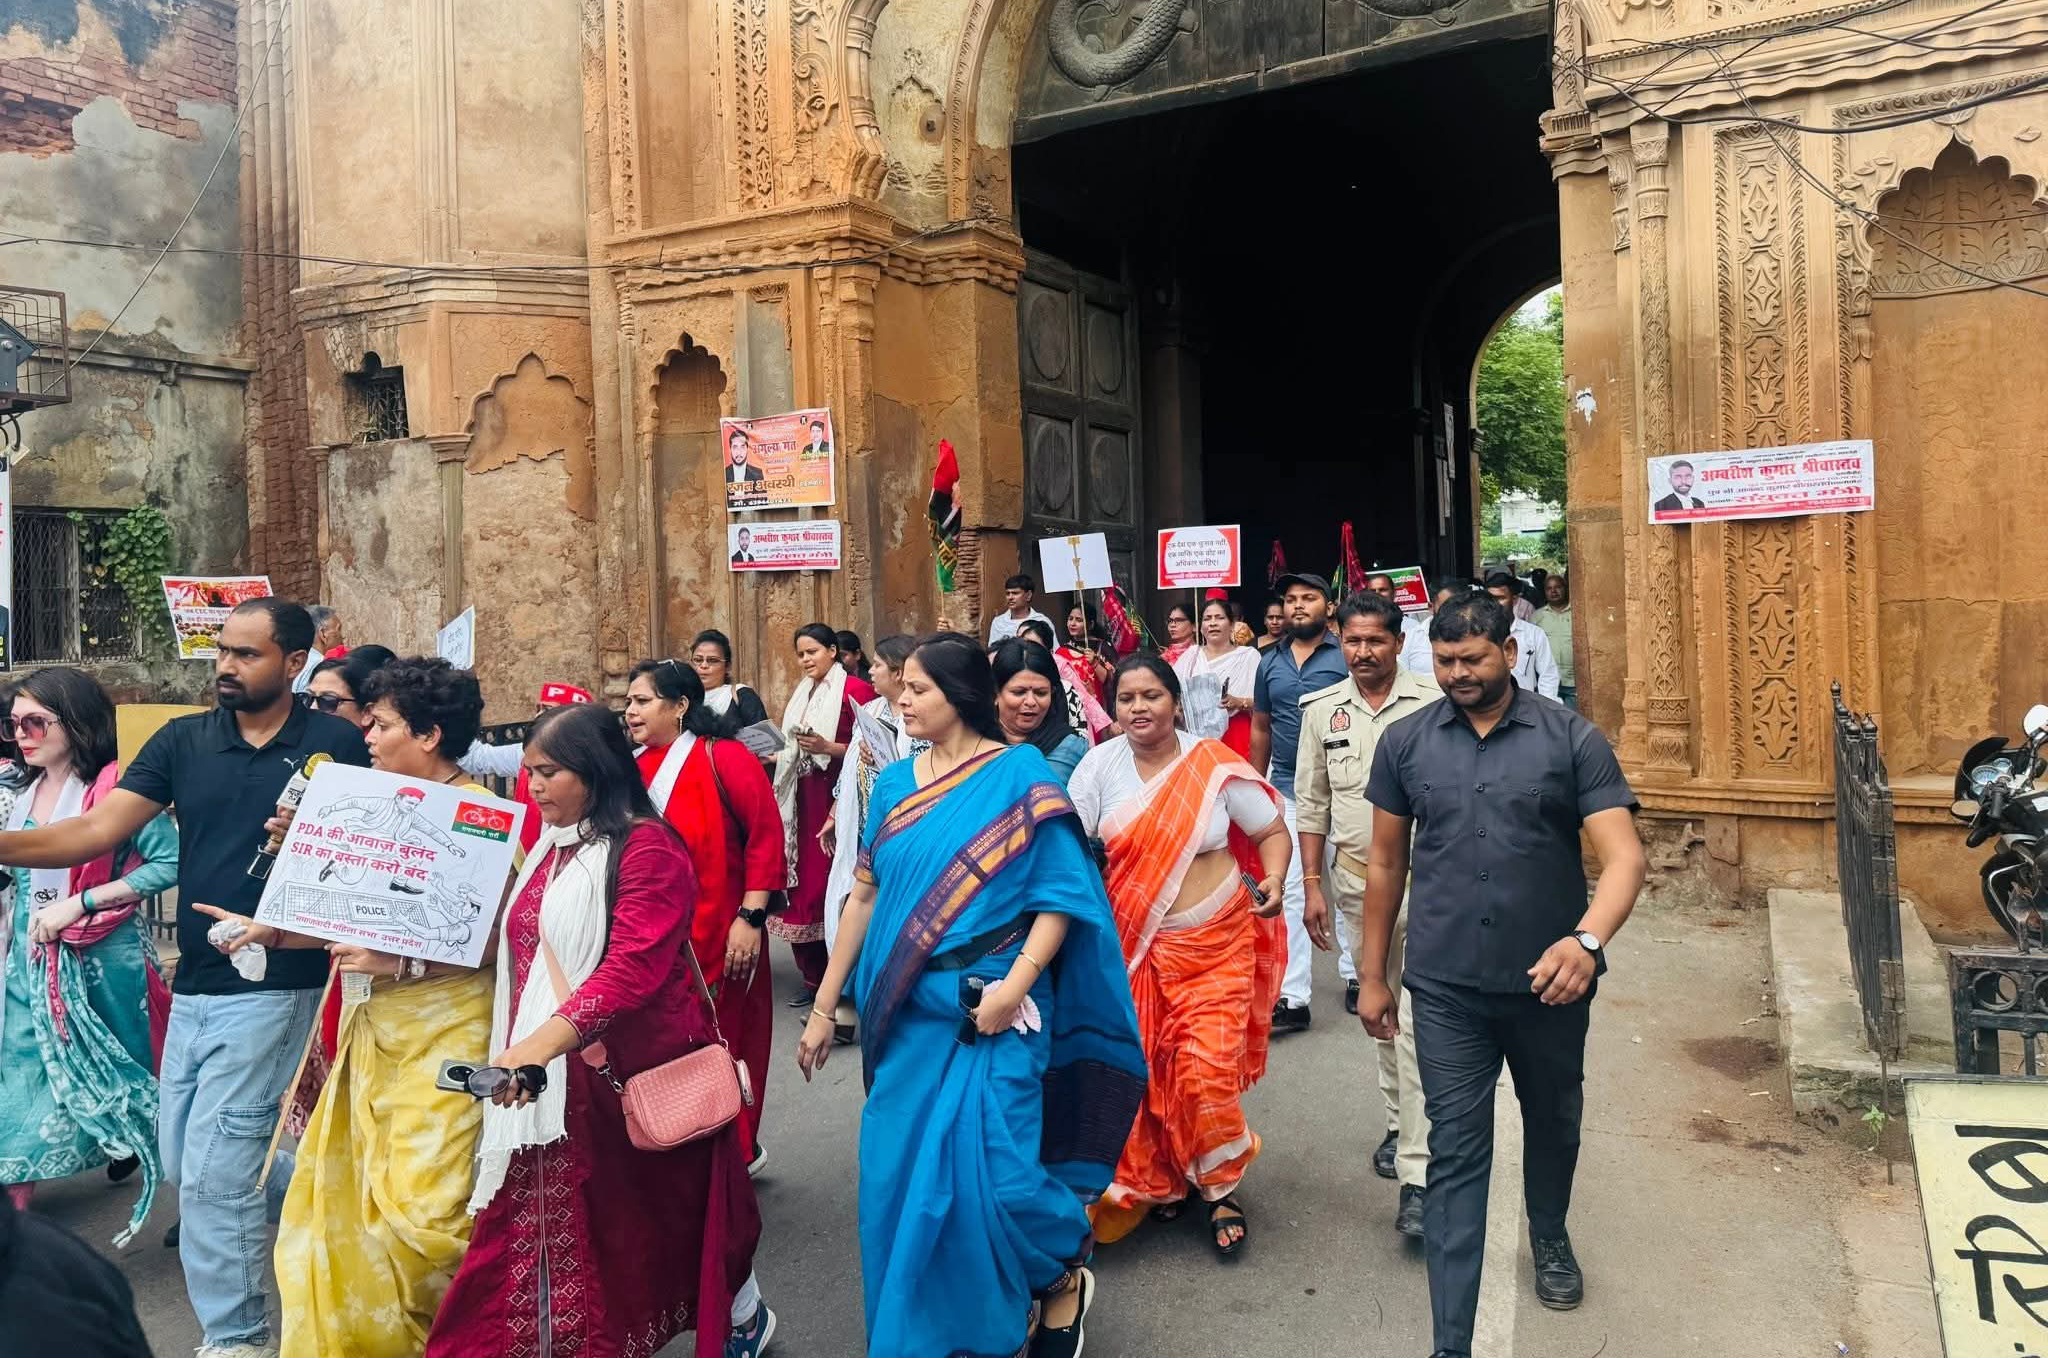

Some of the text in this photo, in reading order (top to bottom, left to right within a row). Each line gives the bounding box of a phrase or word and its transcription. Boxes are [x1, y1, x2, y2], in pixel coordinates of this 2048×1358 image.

[782, 440, 797, 452] मत
[1701, 457, 1862, 483] अम्बरीश कुमार श्रीवास्तव
[755, 475, 795, 491] अवस्थी
[1187, 541, 1197, 549] एक
[1193, 550, 1205, 558] एक
[296, 822, 438, 862] PDA की आवाज़ बुलंद
[290, 841, 430, 882] SIR का बस्ता करो बंद
[355, 904, 387, 917] POLICE
[295, 916, 332, 931] समाजवादी
[331, 921, 358, 936] महिला
[359, 927, 377, 940] सभा
[381, 933, 400, 944] उत्तर
